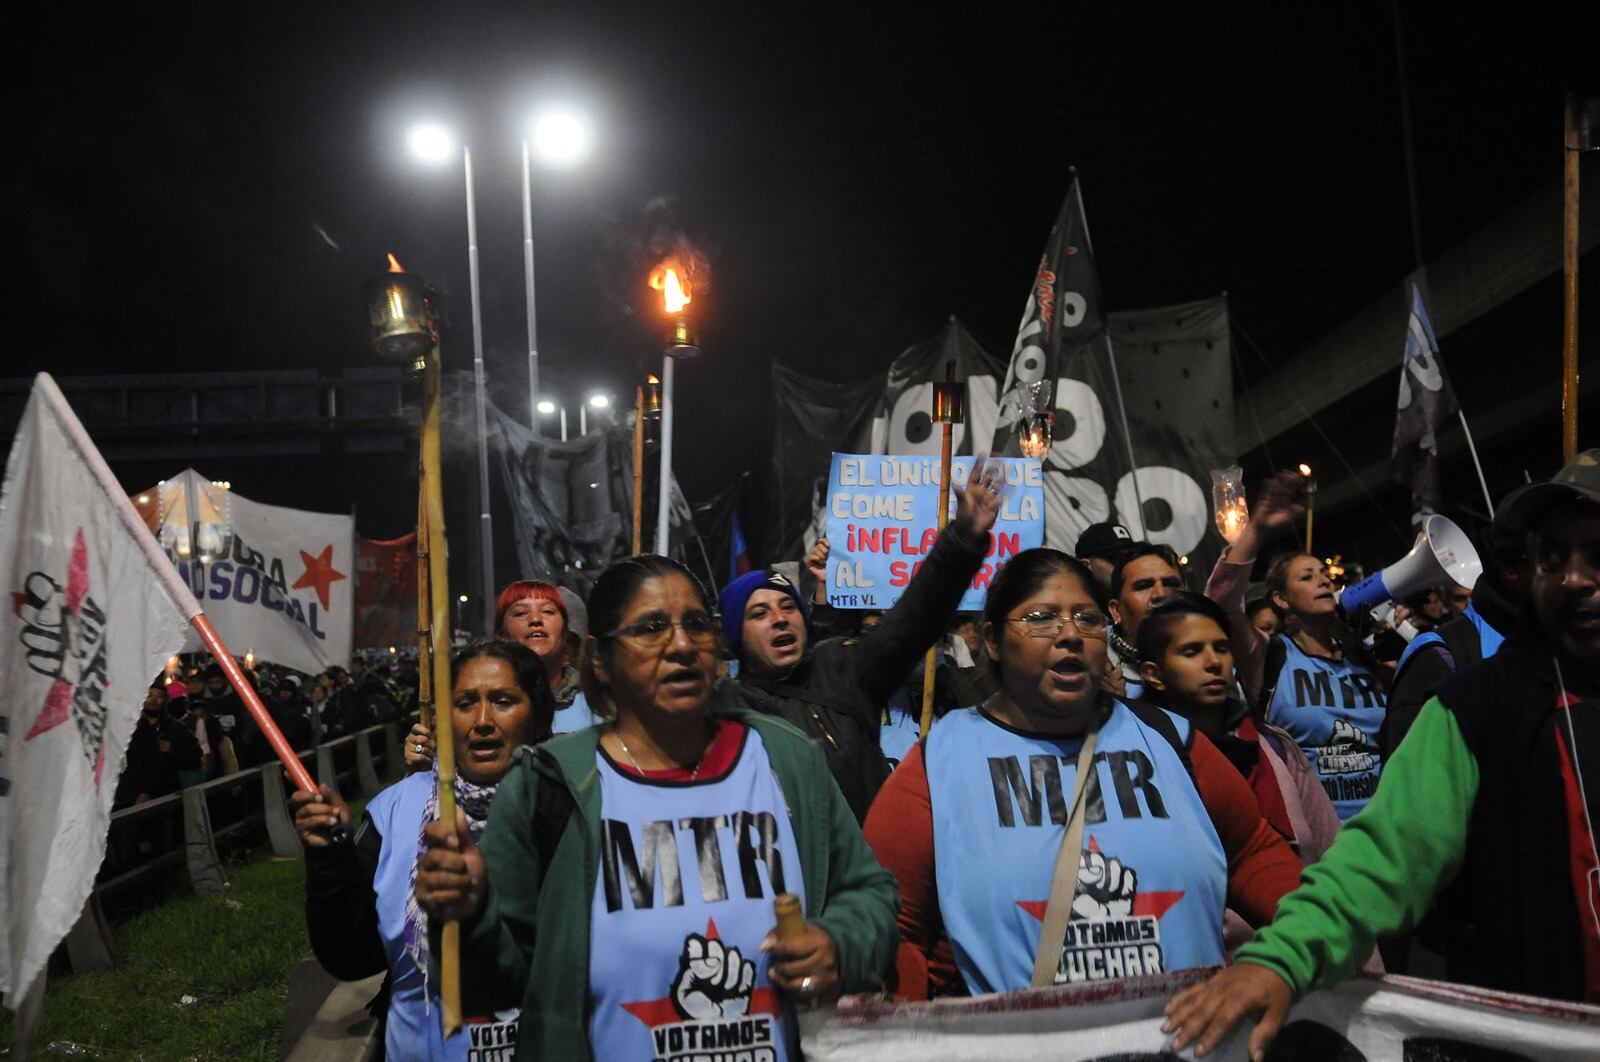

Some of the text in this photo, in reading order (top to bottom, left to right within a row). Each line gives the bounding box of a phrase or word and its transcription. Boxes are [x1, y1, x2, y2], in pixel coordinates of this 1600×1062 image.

[840, 460, 875, 487] EL
[831, 492, 914, 521] COME
[1001, 495, 1039, 521] LA
[835, 561, 874, 588] AL
[830, 594, 858, 607] MTR
[988, 749, 1170, 828] MTR
[601, 810, 787, 914] MTR
[1063, 919, 1156, 947] OTAMOS
[470, 1024, 518, 1047] VOTA
[654, 1019, 771, 1052] VOTAMOS
